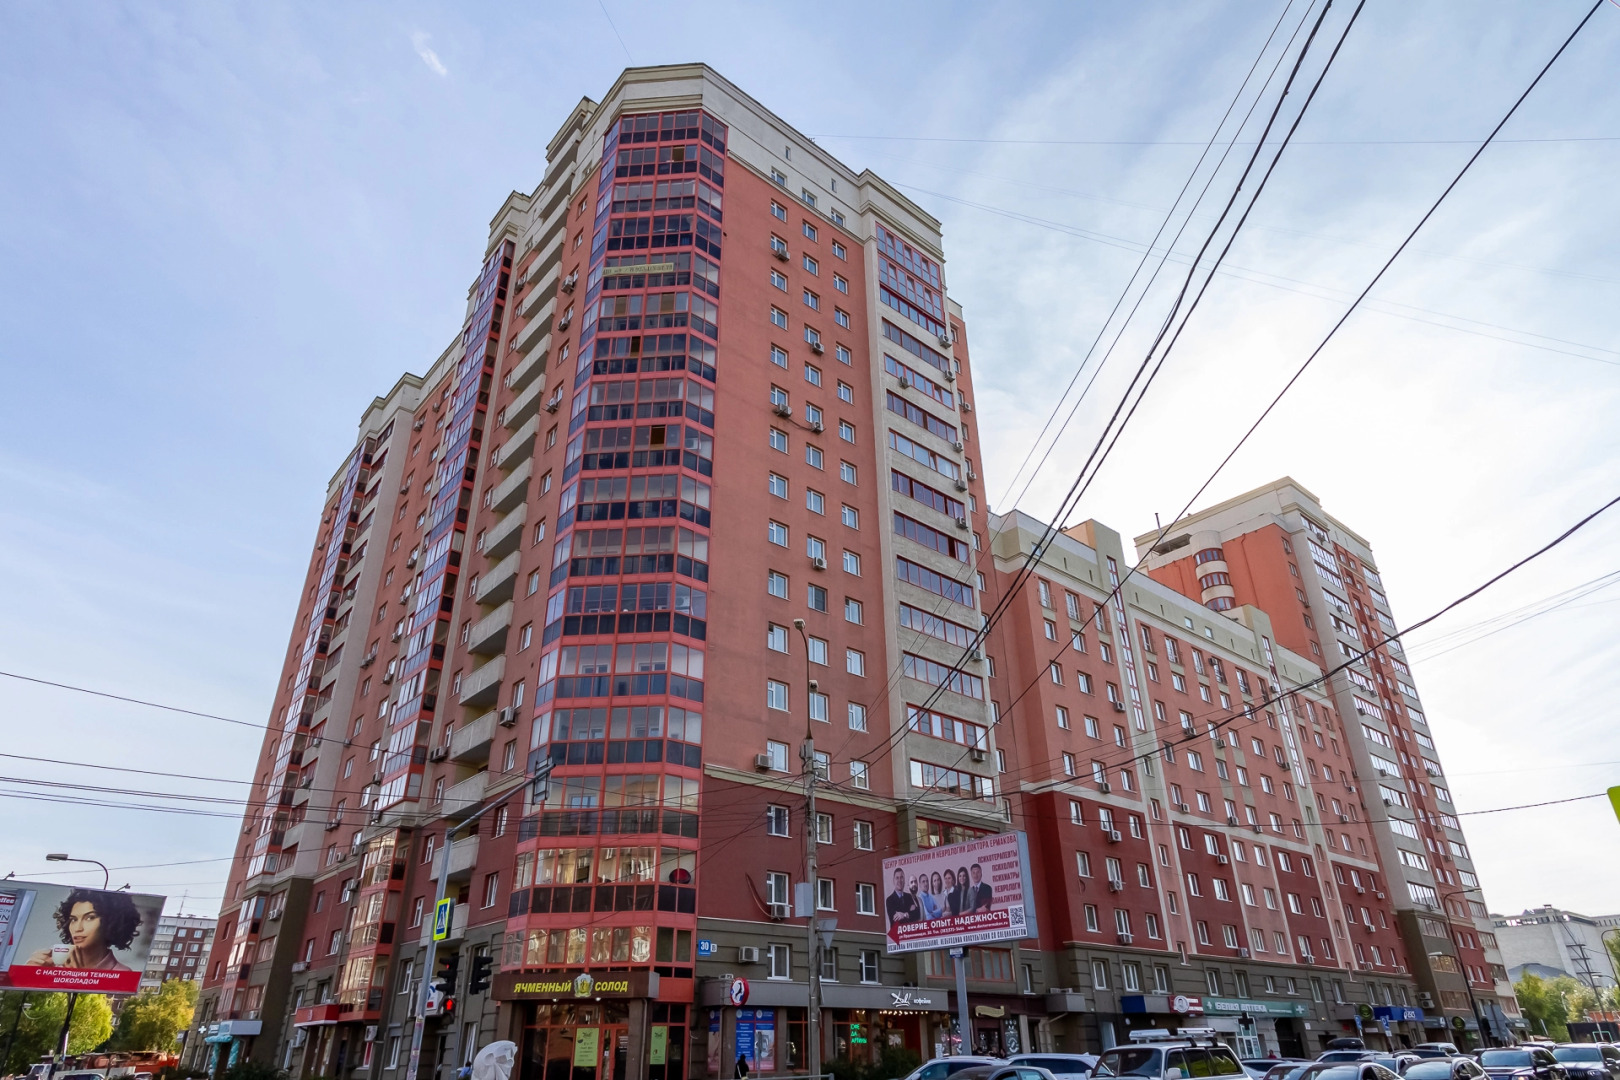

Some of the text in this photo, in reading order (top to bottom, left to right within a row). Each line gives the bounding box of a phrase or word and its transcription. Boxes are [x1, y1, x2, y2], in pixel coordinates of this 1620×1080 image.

[884, 860, 897, 869] ЦЕНТР
[898, 853, 931, 866] ПСИХОТЕРАПИИ
[936, 845, 966, 858] НЕВРОЛОГИИ
[967, 840, 989, 852] ДОКТОРА
[990, 835, 1017, 847] ЕРМАКОВА
[978, 850, 1017, 863] ПСИХОТЕРАПЕВТЫ
[992, 860, 1018, 871] ПСИХОЛОГИ
[992, 872, 1019, 882] ПСИХИАТРЫ
[995, 882, 1020, 893] НЕВРОЛОГИ
[897, 922, 930, 934] ДОВЕРИЕ.
[931, 919, 954, 928] ОПЫТ.
[954, 911, 1009, 925] НАДЕЖНОСТЬ.
[700, 941, 709, 950] 30
[90, 971, 120, 979] ТЕМНЫМ
[53, 977, 100, 985] ШОКОЛАДОМ
[514, 980, 628, 993] ЯЧМЕННЫЙ СОЛОД
